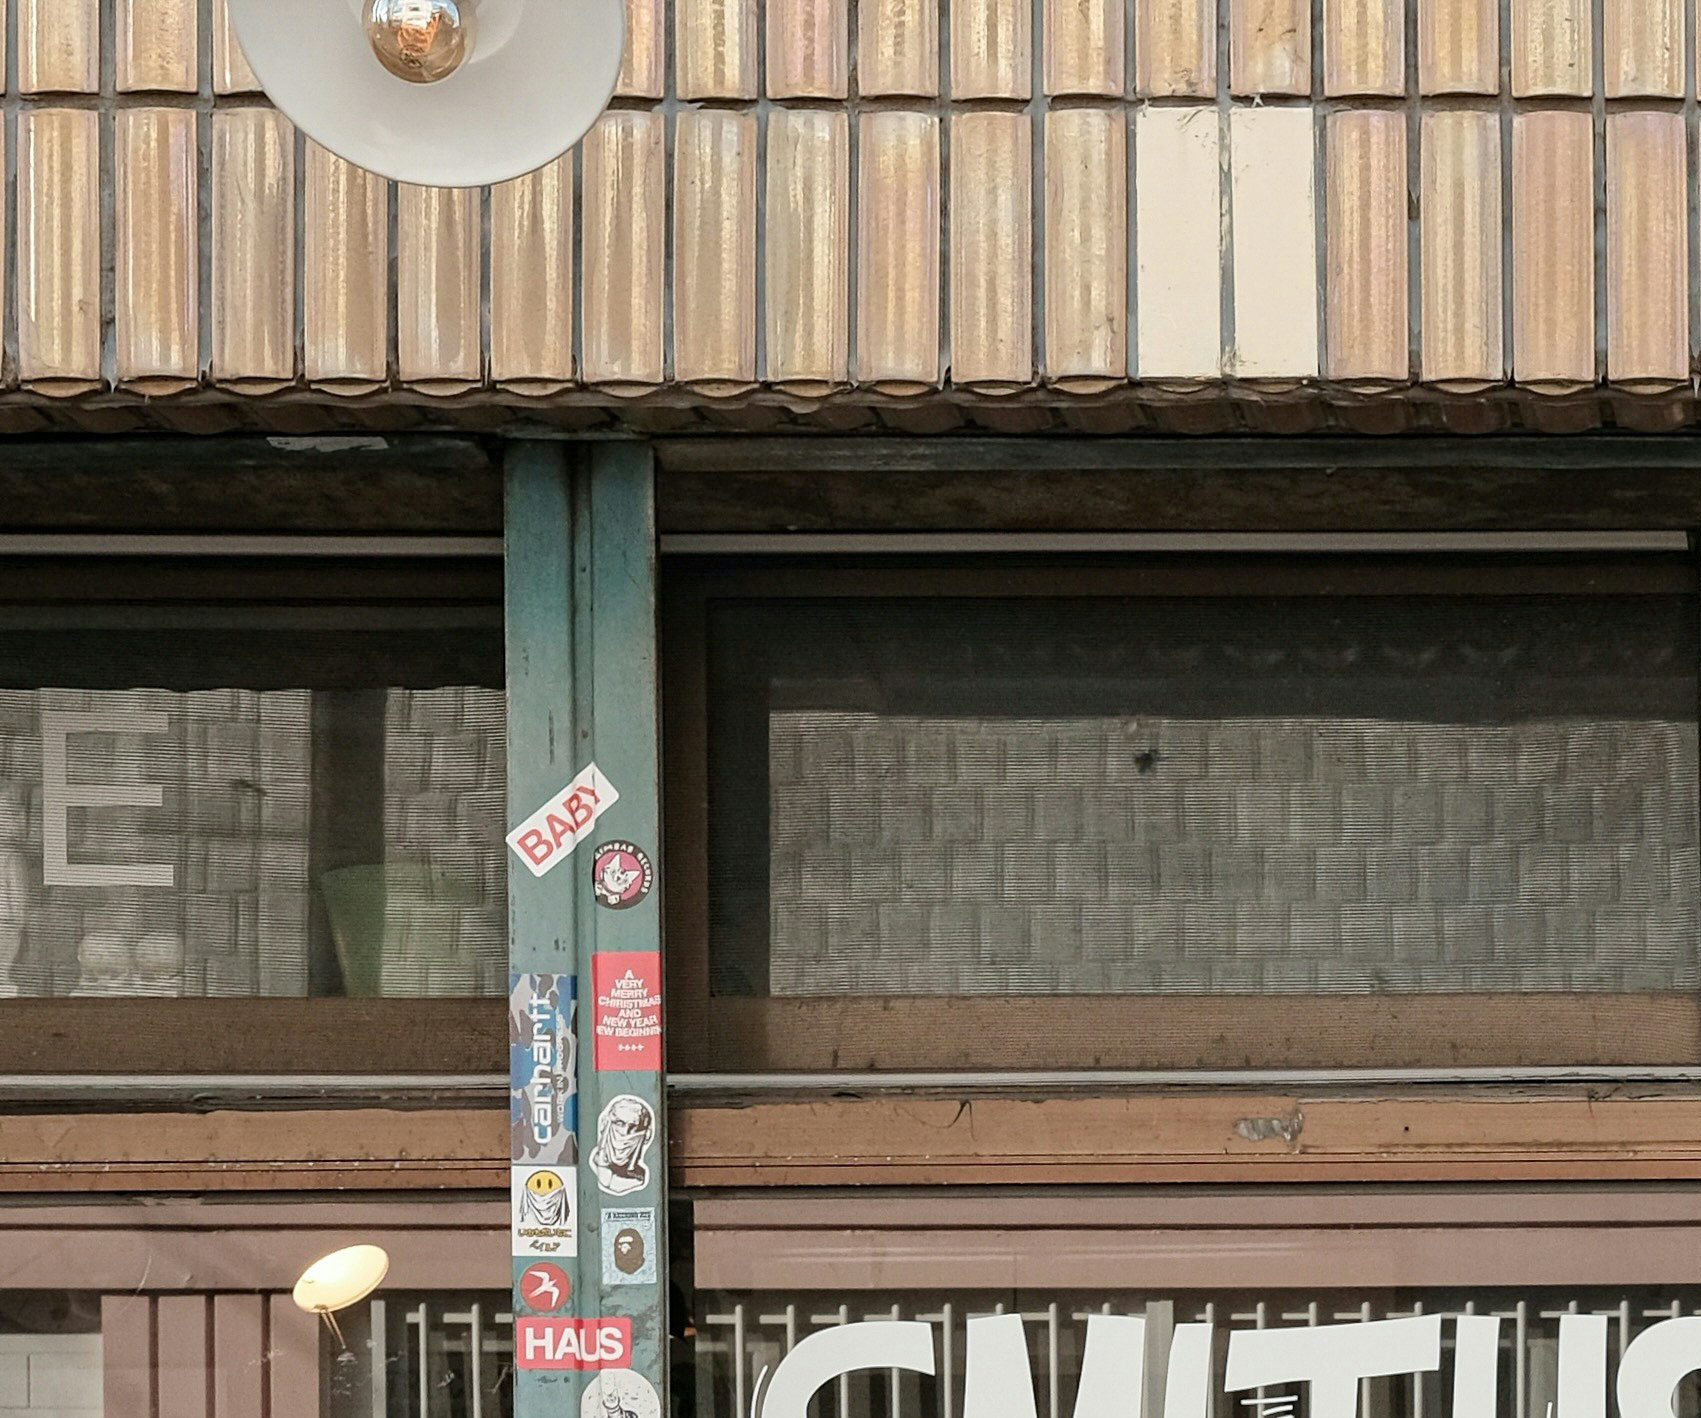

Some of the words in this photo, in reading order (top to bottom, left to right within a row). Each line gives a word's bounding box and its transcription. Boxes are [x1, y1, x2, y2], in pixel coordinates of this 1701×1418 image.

[516, 785, 601, 866] BABY
[624, 969, 635, 979] A
[615, 978, 644, 989] VERY
[610, 987, 649, 999] MERRY
[598, 994, 662, 1009] CHRISTMAS
[618, 1008, 642, 1018] AND
[602, 1014, 628, 1028] NEW
[629, 1014, 659, 1028] YEAR
[528, 992, 553, 1145] carhartt
[525, 1326, 624, 1362] HAUS
